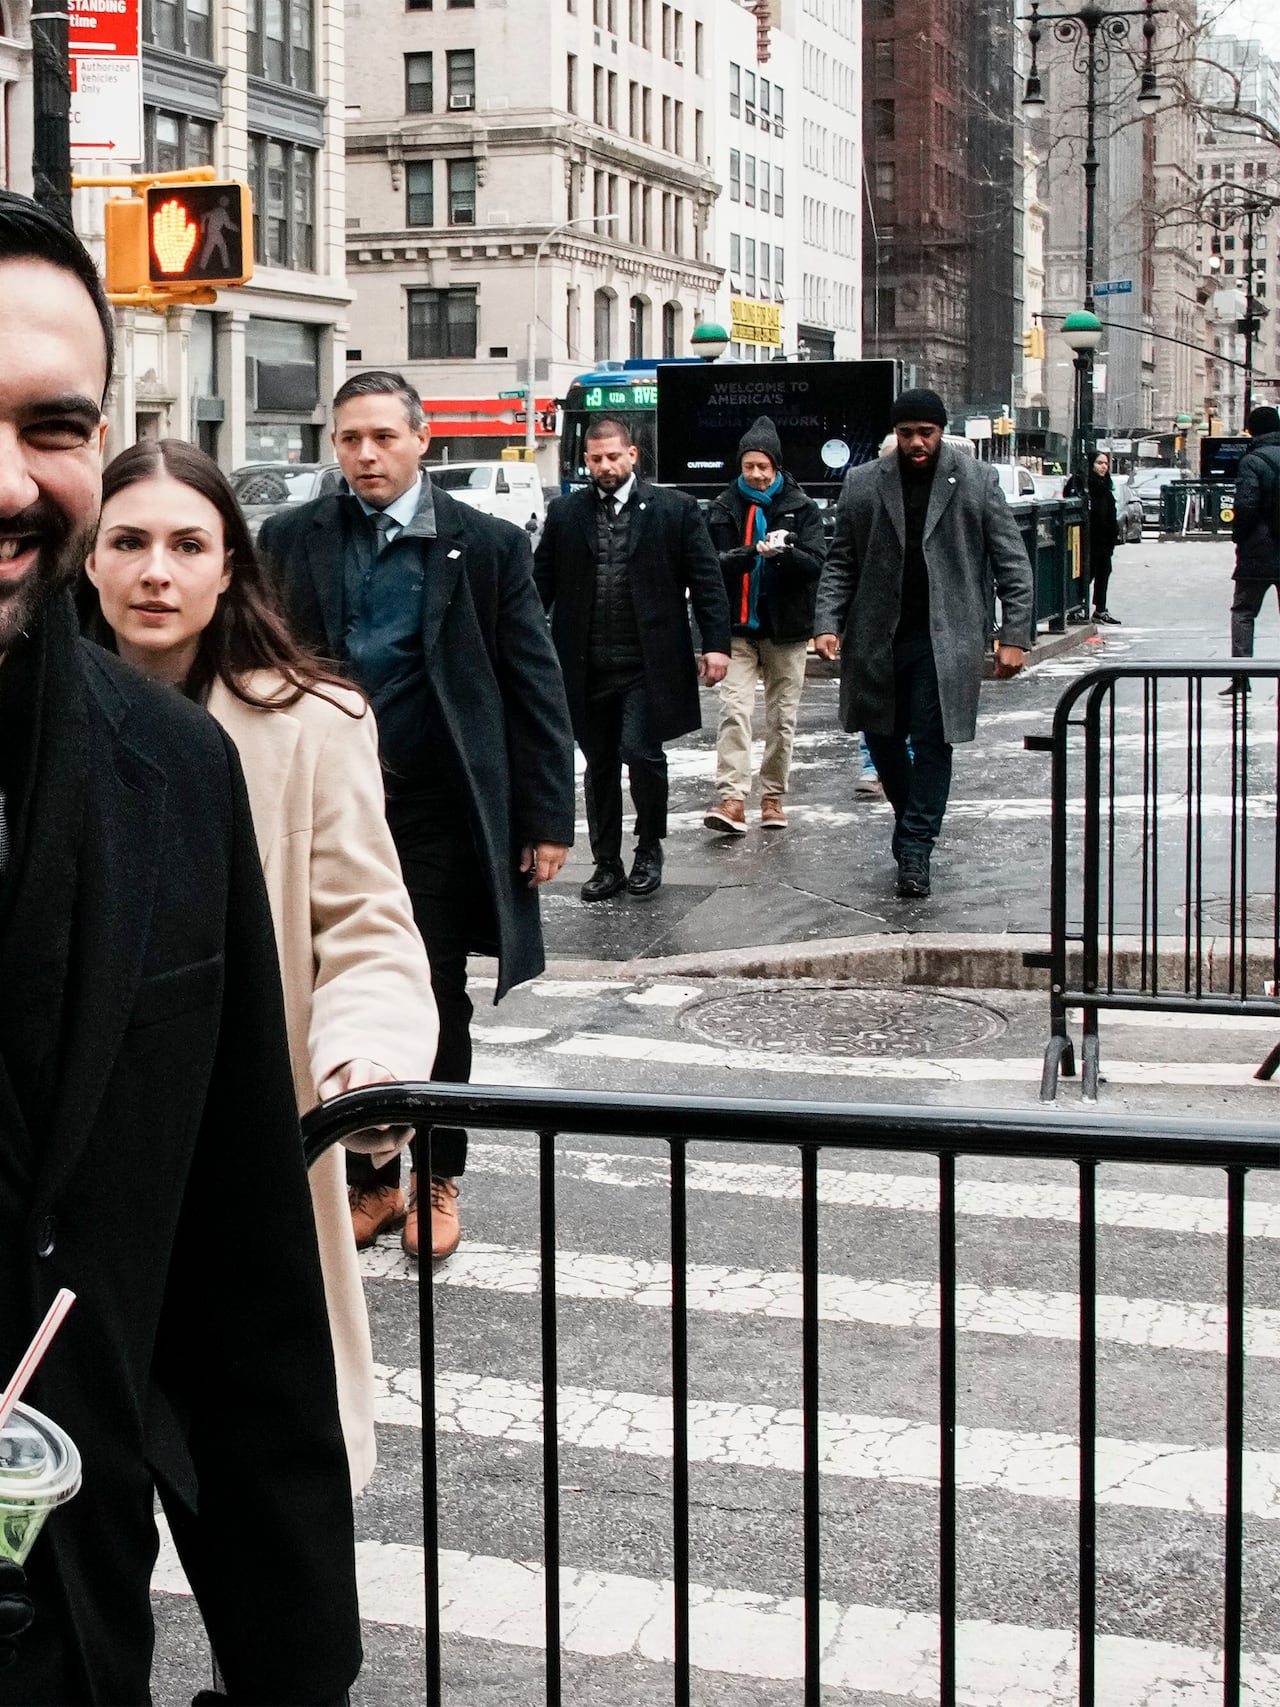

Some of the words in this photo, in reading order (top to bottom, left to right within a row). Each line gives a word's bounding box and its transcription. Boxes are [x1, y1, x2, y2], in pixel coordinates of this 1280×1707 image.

[67, 0, 127, 13] STANDING
[69, 14, 97, 28] time
[80, 62, 130, 72] Authorized
[80, 73, 118, 82] Vehicles
[80, 84, 101, 94] Only
[714, 382, 786, 394] WELCOME
[790, 381, 809, 392] TO
[706, 394, 784, 406] AMERICA'S
